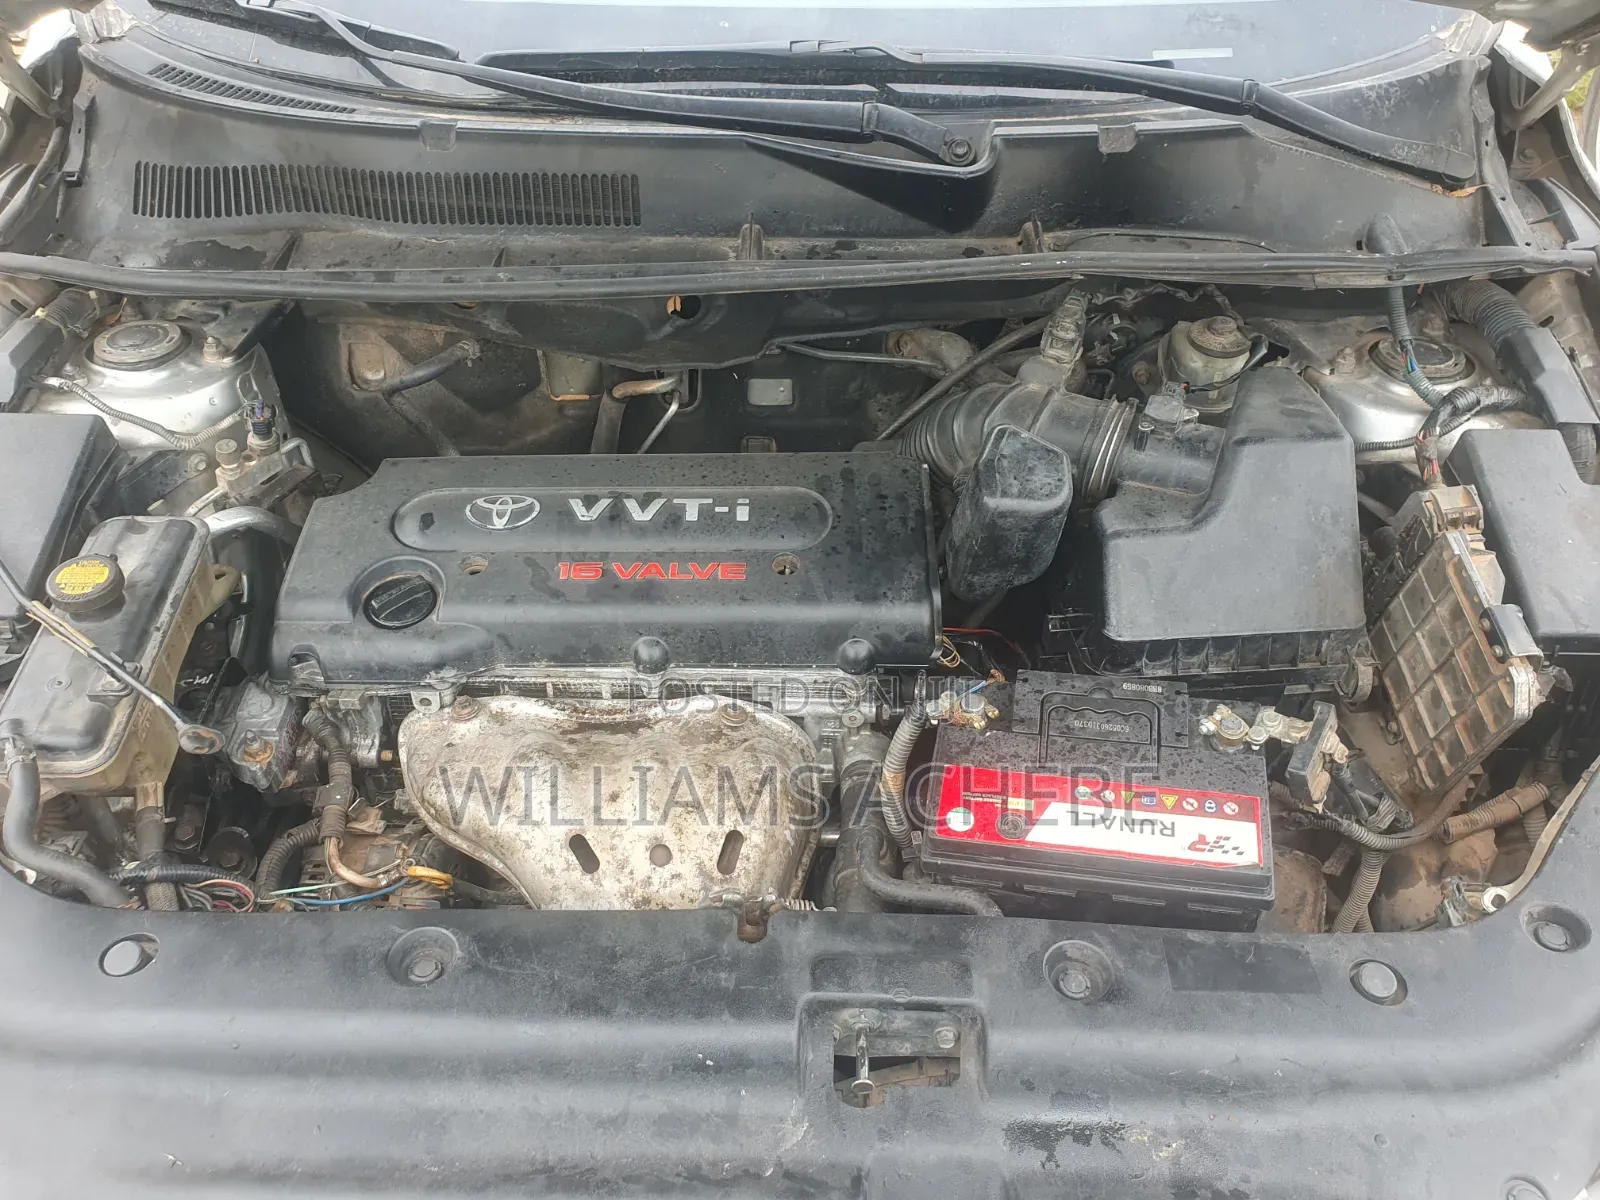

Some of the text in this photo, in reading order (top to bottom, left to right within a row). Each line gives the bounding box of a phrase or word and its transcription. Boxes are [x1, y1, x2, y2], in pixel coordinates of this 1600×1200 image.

[568, 497, 750, 523] VVT-i
[558, 561, 748, 581] 16 VALVE
[1065, 810, 1176, 838] RUNALL
